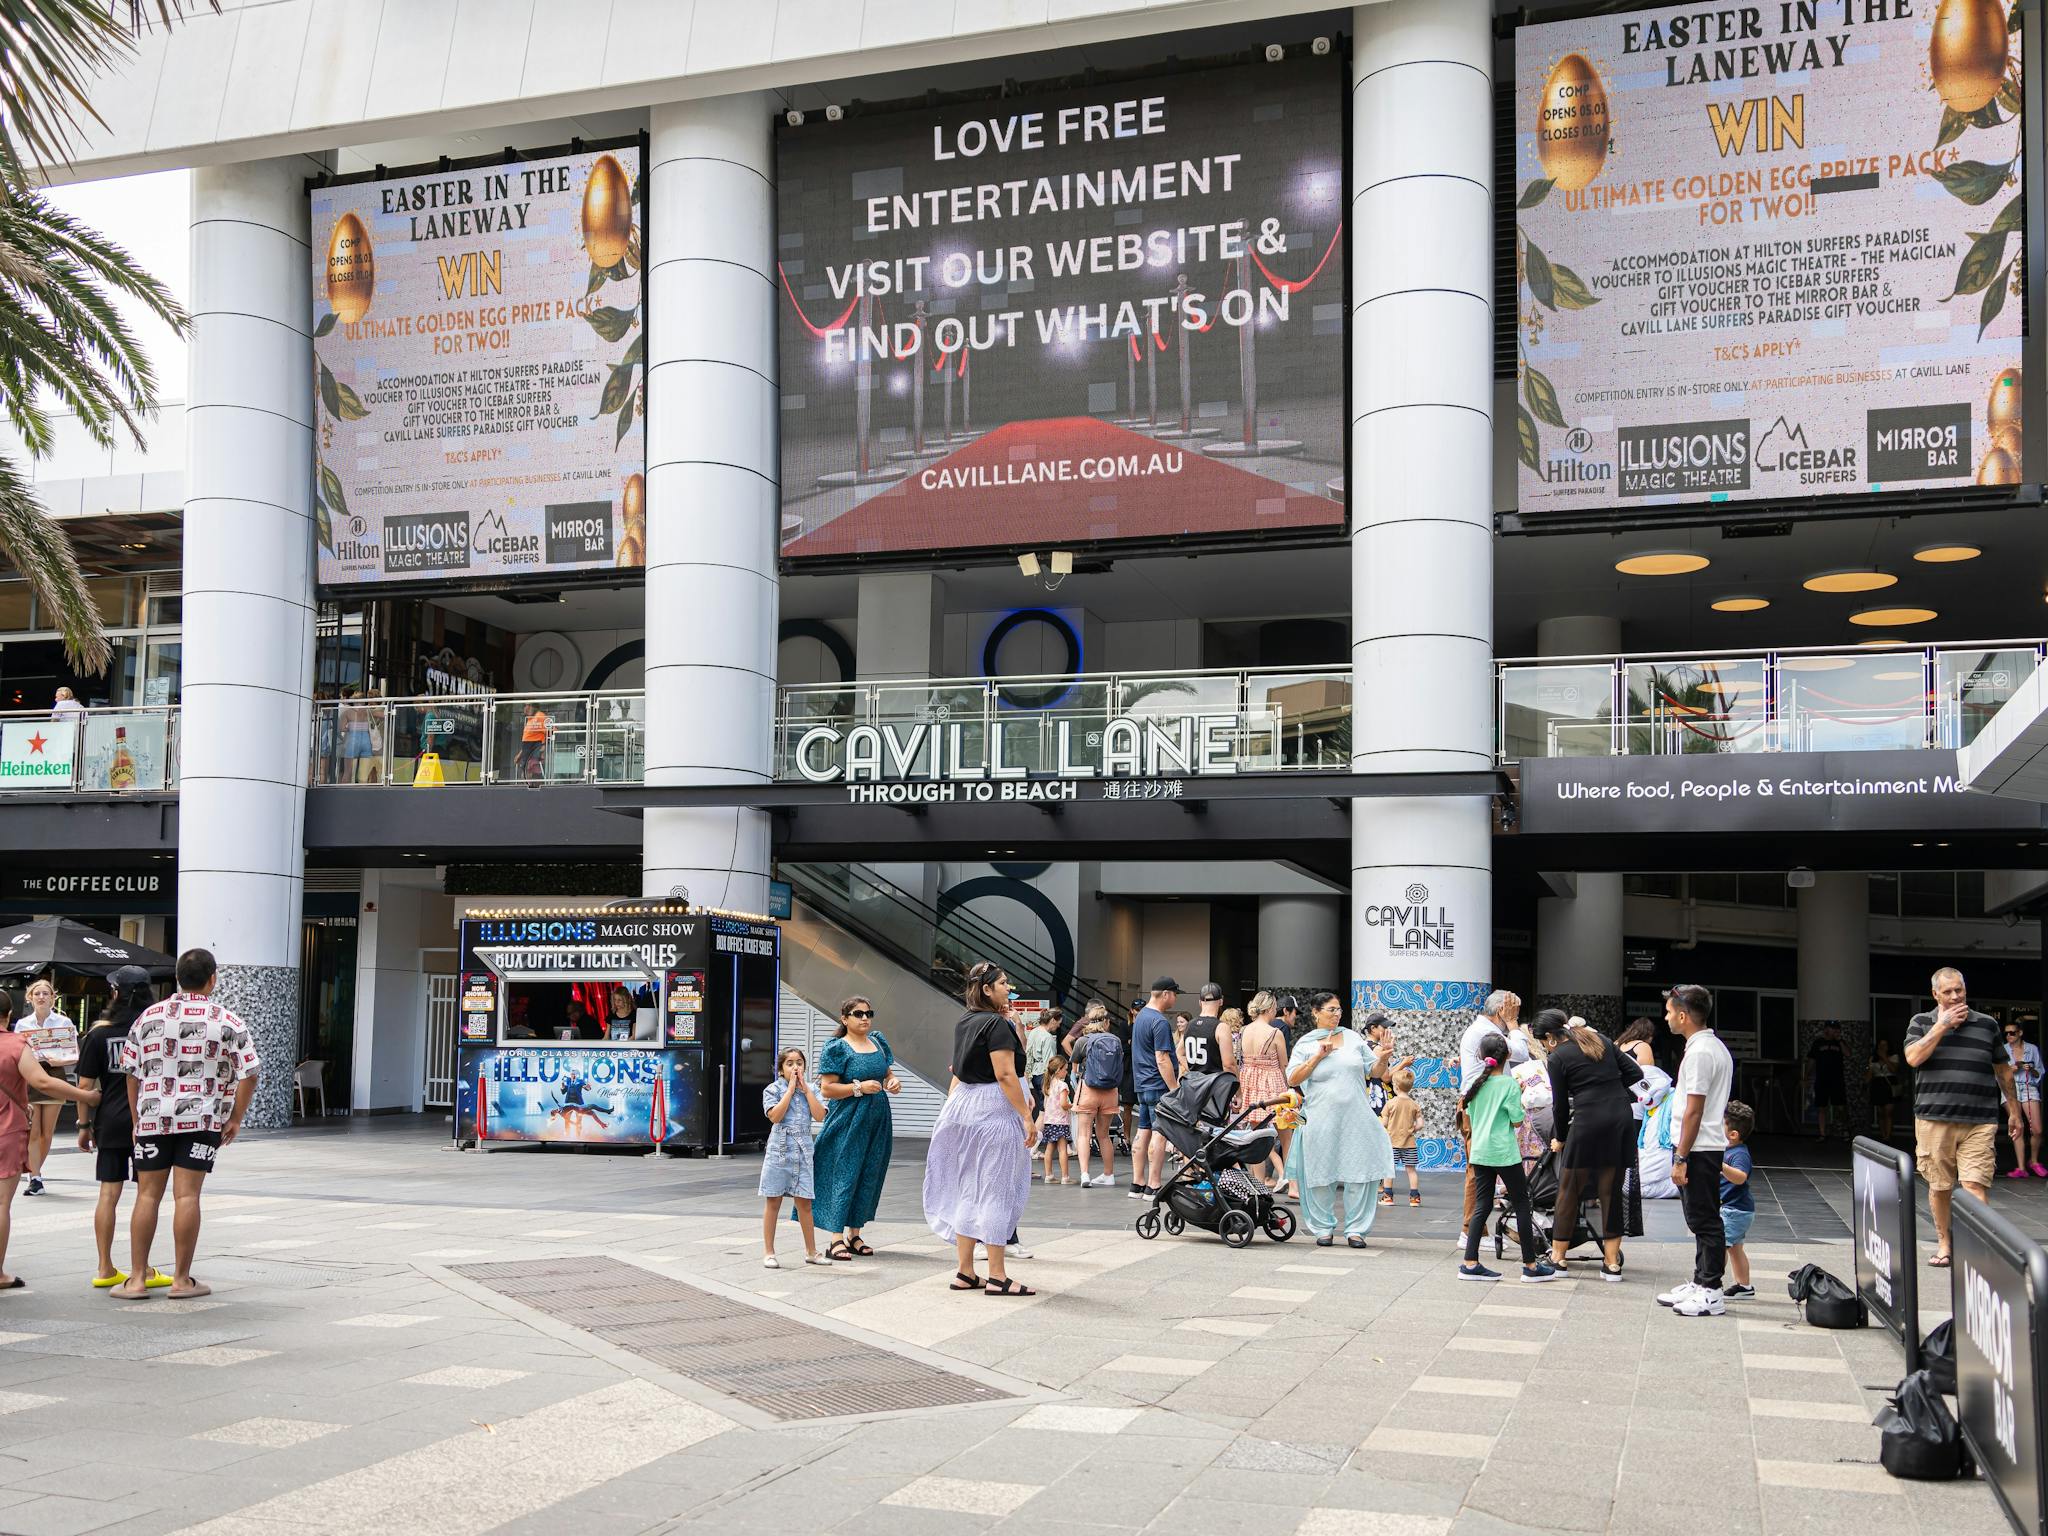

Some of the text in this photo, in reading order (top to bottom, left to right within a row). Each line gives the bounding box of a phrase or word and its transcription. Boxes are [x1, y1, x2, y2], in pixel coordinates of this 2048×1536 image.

[1622, 0, 1913, 53] EASTER IN THE
[1665, 34, 1851, 87] LANEWAY
[1560, 84, 1589, 98] COMP
[1544, 102, 1606, 120] OPENS 05.03
[934, 96, 1166, 160] LOVE FREE
[1542, 123, 1607, 140] CLOSES 01.04
[1706, 94, 1804, 158] WIN
[381, 166, 571, 214] EASTER IN THE
[866, 154, 1242, 233] ENTERTAINMENT
[1565, 179, 1665, 213] ULTIMATE
[1672, 169, 1761, 200] GOLDEN
[1770, 164, 1812, 191] EGG
[1820, 156, 1880, 179] PRIZE
[410, 203, 530, 242] LANEWAY
[1700, 194, 1816, 226] FOR TWO!!
[825, 216, 1288, 300] VISIT OUR WEBSITE &
[1612, 228, 1930, 272] ACCOMMODATION AT HILTON SURFERS PARADISE
[437, 250, 502, 300] WIN
[1592, 272, 1650, 290] VOUCHER
[1654, 270, 1672, 284] TO
[1676, 263, 1742, 282] ILLUSIONS
[1746, 258, 1788, 276] MAGIC
[1791, 254, 1846, 272] THEATRE
[1861, 250, 1884, 264] THE
[1889, 243, 1956, 262] MAGICIAN
[1658, 268, 1880, 300] GIFT VOUCHER TO ICEBAR SURFERS
[1650, 282, 1892, 317] GIFT VOUCHER TO THE MIRROR BAR &
[345, 316, 412, 341] ULTIMATE
[416, 311, 477, 335] GOLDEN
[479, 308, 506, 328] EGG
[511, 302, 551, 325] PRIZE
[824, 284, 1291, 364] FIND OUT WHAT'S ON
[1621, 298, 1920, 336] CAVILL LANE SURFERS PARADISE GIFT VOUCHER
[434, 330, 510, 355] FOR TWO!!
[1714, 343, 1750, 361] T&C'S
[1574, 364, 1970, 404] COMPETITION ENTRY IS IN-STORE ONLY AT PARTICIPATING BUSINESSES AT CAVILL LANE
[1876, 425, 1957, 452] MIRROR
[1620, 432, 1746, 472] ILLUSIONS
[1779, 448, 1856, 472] ICEBAR
[1927, 450, 1958, 467] BAR
[921, 452, 1184, 490] CAVILLLANE.COM.AU
[1548, 458, 1611, 483] Hilton
[1625, 468, 1741, 490] MAGIC THEATRE
[1800, 470, 1857, 484] SURFERS
[1552, 486, 1604, 496] SURFERS PARADISE
[385, 522, 468, 552] ILLUSIONS
[552, 518, 604, 539] MIRROR
[338, 541, 380, 560] Hilton
[488, 536, 539, 554] ICEBAR
[584, 538, 604, 552] BAR
[388, 551, 464, 568] MAGIC THEATRE
[502, 553, 540, 565] SURFERS
[794, 714, 1240, 783] CAVILL LANE
[0, 760, 70, 776] Heineken
[846, 780, 1078, 803] THROUGH TO BEACH
[1102, 780, 1184, 800] 通往沙滩
[1558, 776, 1968, 800] Where food, People & Entertainment Me
[23, 876, 160, 892] THE COFFEE CLUB
[1365, 906, 1454, 928] CAVILL
[480, 922, 695, 942] ILLUSIONS MAGIC SHOW
[750, 926, 764, 936] MAGIC
[1390, 928, 1454, 950] LANE
[495, 944, 677, 968] BOX OFFICE TICKET SALES
[716, 934, 727, 950] BOX
[727, 936, 744, 952] OFFICE
[759, 940, 772, 956] SALES
[1420, 950, 1454, 958] PARADISE
[582, 1050, 618, 1058] MAGIC
[622, 1050, 656, 1058] SHOW
[1184, 1036, 1208, 1066] 05
[494, 1058, 662, 1084] ILLUSIONS
[134, 1143, 160, 1160] 合う
[1964, 1260, 2014, 1392] MIRROR
[1994, 1376, 2018, 1464] BAR
